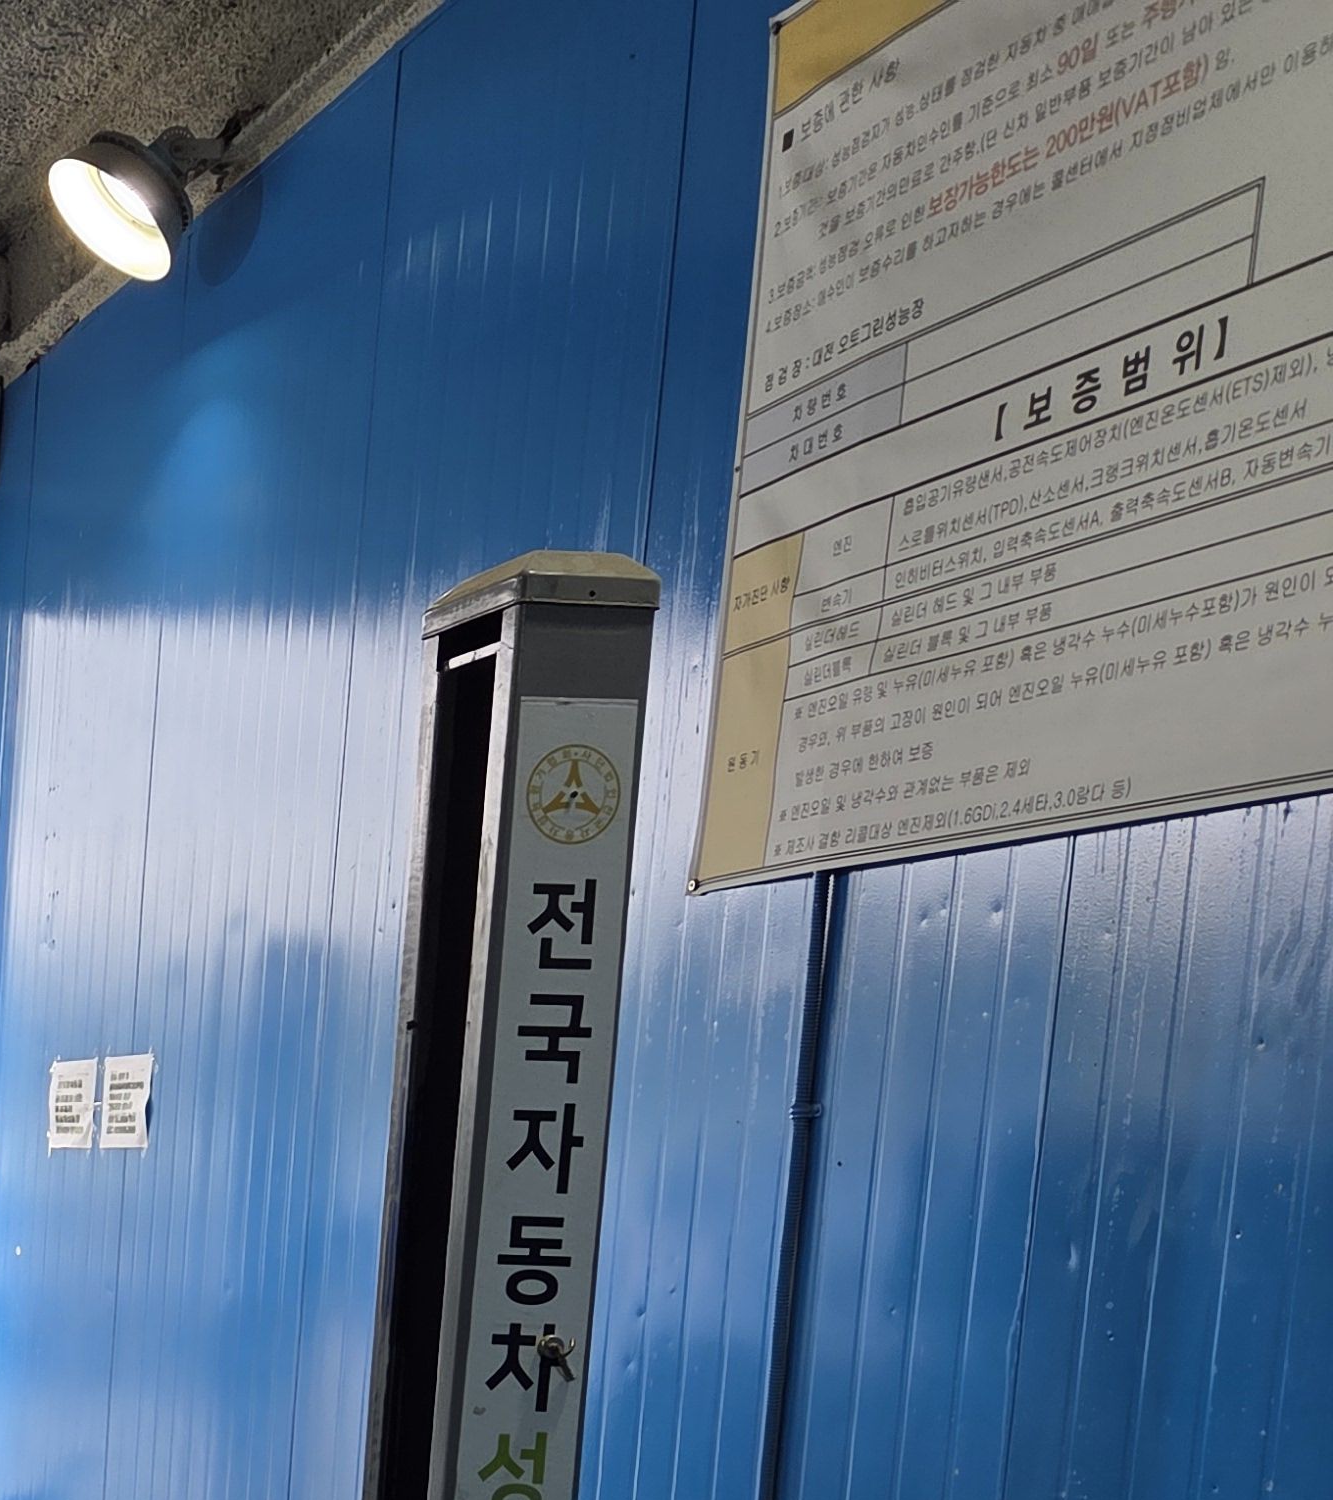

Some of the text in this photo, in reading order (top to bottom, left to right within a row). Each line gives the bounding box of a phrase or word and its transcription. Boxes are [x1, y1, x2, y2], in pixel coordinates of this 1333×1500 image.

[967, 79, 1021, 124] 기준으로
[1026, 63, 1053, 92] 최소
[1057, 32, 1099, 76] 90일
[1105, 22, 1135, 50] 또는
[1003, 104, 1029, 138] 신차
[1034, 77, 1092, 124] 일반부품
[1097, 32, 1176, 90] 보증기간이
[1182, 11, 1214, 46] 남아
[1004, 25, 1048, 64] 자동차
[801, 58, 901, 141] 보증에 관한 사항
[900, 203, 927, 231] 인한
[928, 142, 1040, 218] 보장가능한도는
[1045, 52, 1210, 160] 200만원(VAT포함)
[921, 210, 987, 252] 하고자하는
[991, 182, 1045, 221] 경우에는
[1128, 61, 1277, 153] 지정정비업체에서만
[836, 296, 925, 355] 오트그린성능장
[1243, 433, 1331, 481] 자동변속기
[832, 535, 853, 557] 엔진
[890, 600, 929, 628] 실린더
[932, 594, 959, 616] 헤드
[979, 581, 994, 600] 그
[997, 571, 1025, 595] 내부
[1028, 561, 1058, 586] 부품
[807, 692, 850, 719] 엔진오일
[980, 648, 1015, 674] 포함)
[1019, 640, 1048, 663] 혹은
[1052, 628, 1097, 657] 냉각수
[1263, 568, 1317, 602] 원인이
[882, 638, 923, 664] 실린더
[975, 619, 989, 639] 그
[993, 610, 1021, 634] 내부
[1024, 601, 1053, 625] 부품
[835, 725, 847, 744] 위
[850, 715, 885, 740] 부품의
[889, 705, 927, 731] 고장이
[931, 694, 972, 722] 원인이
[975, 686, 1003, 711] 되어
[1007, 673, 1065, 705] 엔진오일
[1172, 637, 1213, 666] 포함)
[1217, 629, 1252, 654] 혹은
[1257, 616, 1310, 647] 냉각수
[789, 797, 831, 822] 엔진오일
[850, 785, 899, 810] 냉각수와
[902, 774, 955, 799] 관계없는
[959, 764, 999, 788] 부품은
[1003, 757, 1031, 780] 제외
[828, 756, 863, 780] 경우에
[868, 747, 904, 771] 한하여
[907, 740, 935, 763] 보증
